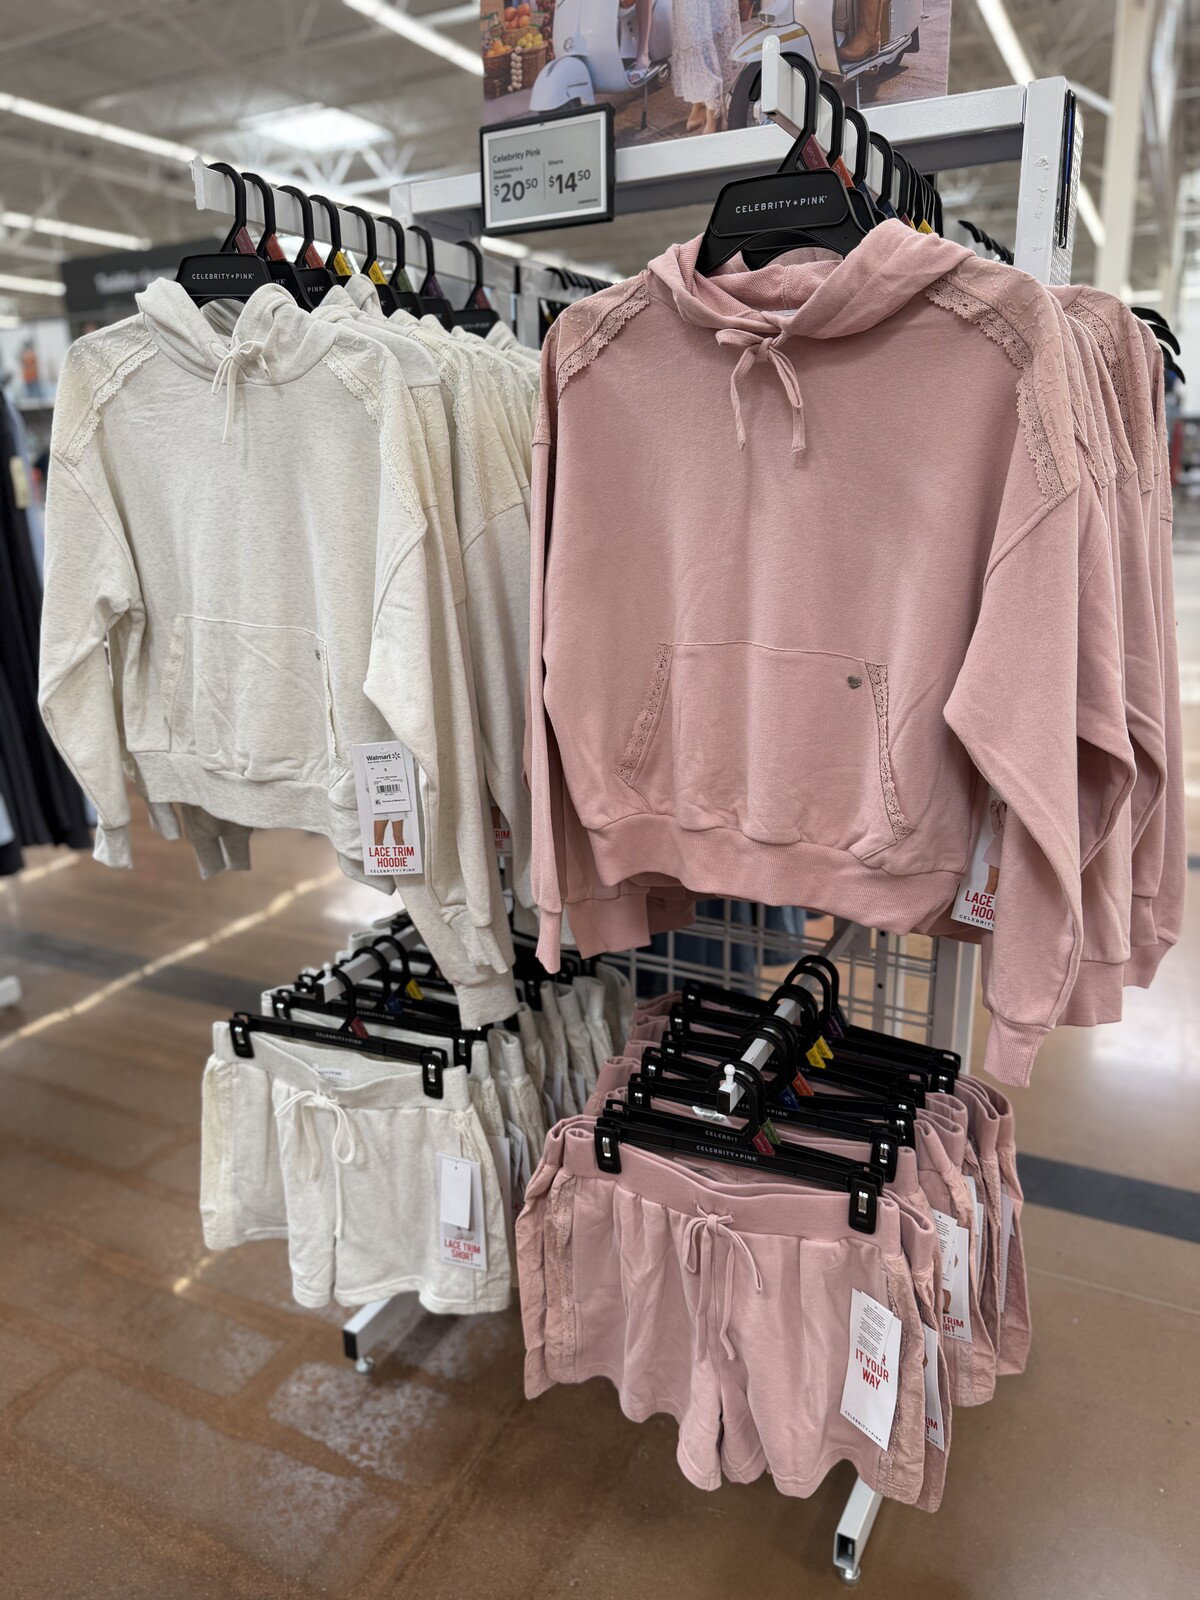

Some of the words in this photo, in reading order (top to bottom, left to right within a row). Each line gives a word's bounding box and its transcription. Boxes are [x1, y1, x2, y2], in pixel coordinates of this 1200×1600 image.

[492, 152, 524, 163] Celebrity
[525, 148, 541, 157] Pink
[548, 172, 577, 194] $14
[577, 169, 591, 181] 50
[493, 181, 525, 203] $20
[525, 178, 538, 189] 50
[735, 199, 791, 214] CELEBRITY
[800, 195, 825, 206] PINK
[366, 753, 392, 762] Walmart
[495, 830, 510, 840] RIM
[368, 847, 391, 857] LACE
[392, 846, 415, 857] TRIM
[377, 857, 408, 868] HOODIE
[965, 890, 994, 907] LACE
[970, 904, 995, 921] HOO
[705, 1130, 738, 1142] CELEBRIT
[444, 1238, 462, 1250] LACE
[463, 1242, 481, 1254] TRIM
[451, 1249, 474, 1261] SHORT
[855, 1347, 864, 1363] IT
[865, 1355, 889, 1383] YOUR
[862, 1367, 881, 1390] WAY
